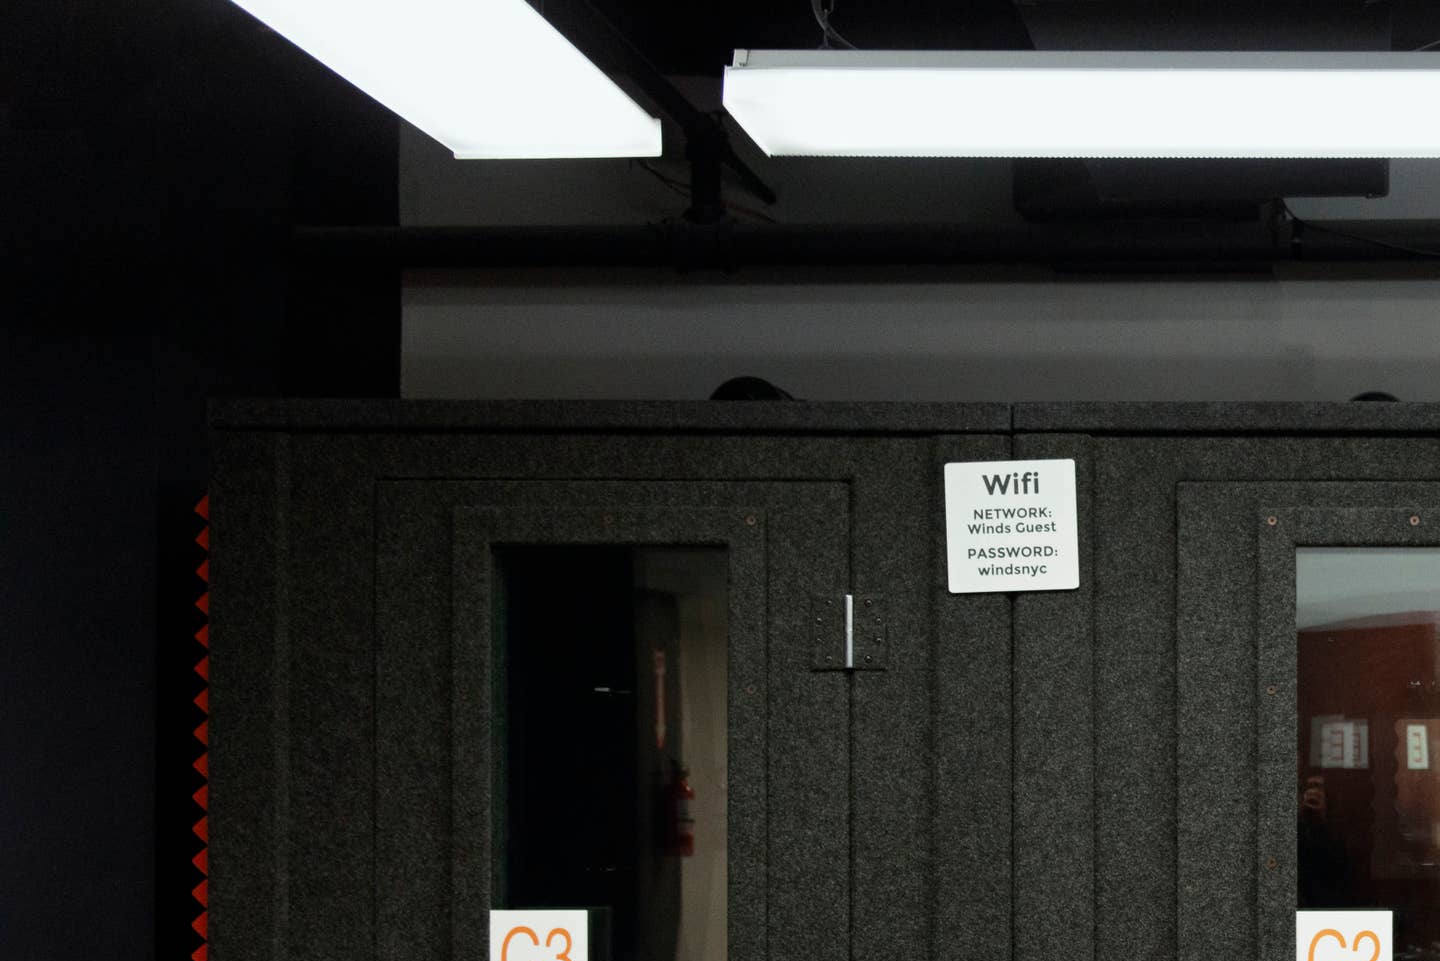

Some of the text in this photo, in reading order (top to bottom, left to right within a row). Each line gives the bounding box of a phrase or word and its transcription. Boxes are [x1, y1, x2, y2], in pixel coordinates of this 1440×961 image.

[982, 472, 1039, 495] Wifi
[973, 507, 1052, 520] NETWORK:
[968, 522, 1057, 534] Winds Guest
[968, 546, 1058, 559] PASSWORD:
[978, 564, 1048, 577] windsnyc
